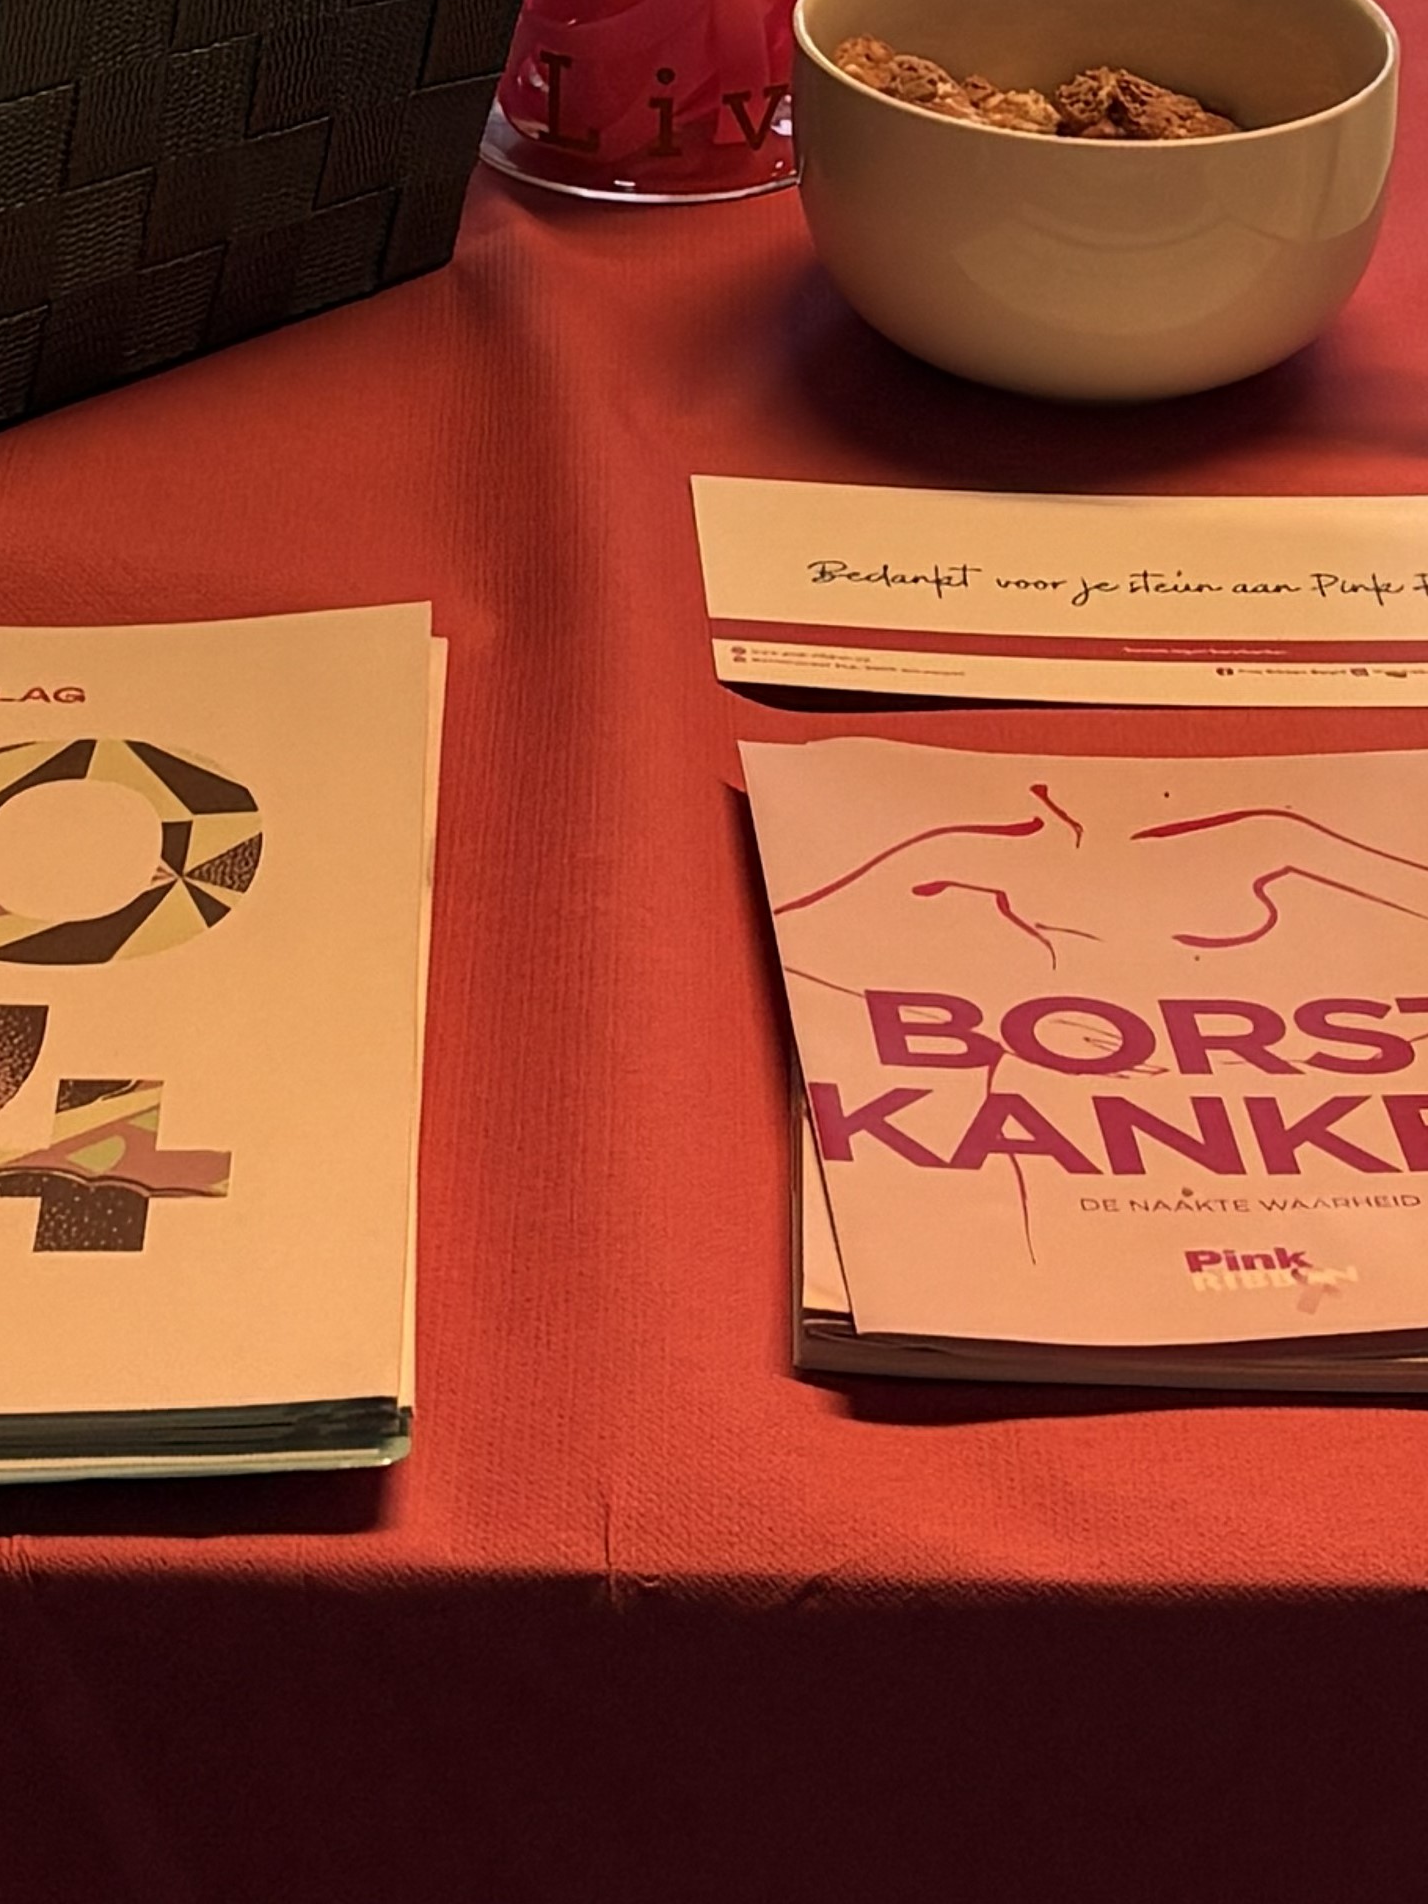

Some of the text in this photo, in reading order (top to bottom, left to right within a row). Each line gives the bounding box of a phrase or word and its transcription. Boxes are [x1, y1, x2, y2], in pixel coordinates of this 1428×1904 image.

[807, 560, 983, 600] Bedankt
[996, 578, 1068, 592] voor
[1072, 575, 1120, 607] je
[1232, 582, 1302, 594] aan
[1310, 572, 1405, 607] Pink
[1079, 1194, 1422, 1213] DE NAAKTE WAARHEID
[1184, 1247, 1314, 1273] Pink
